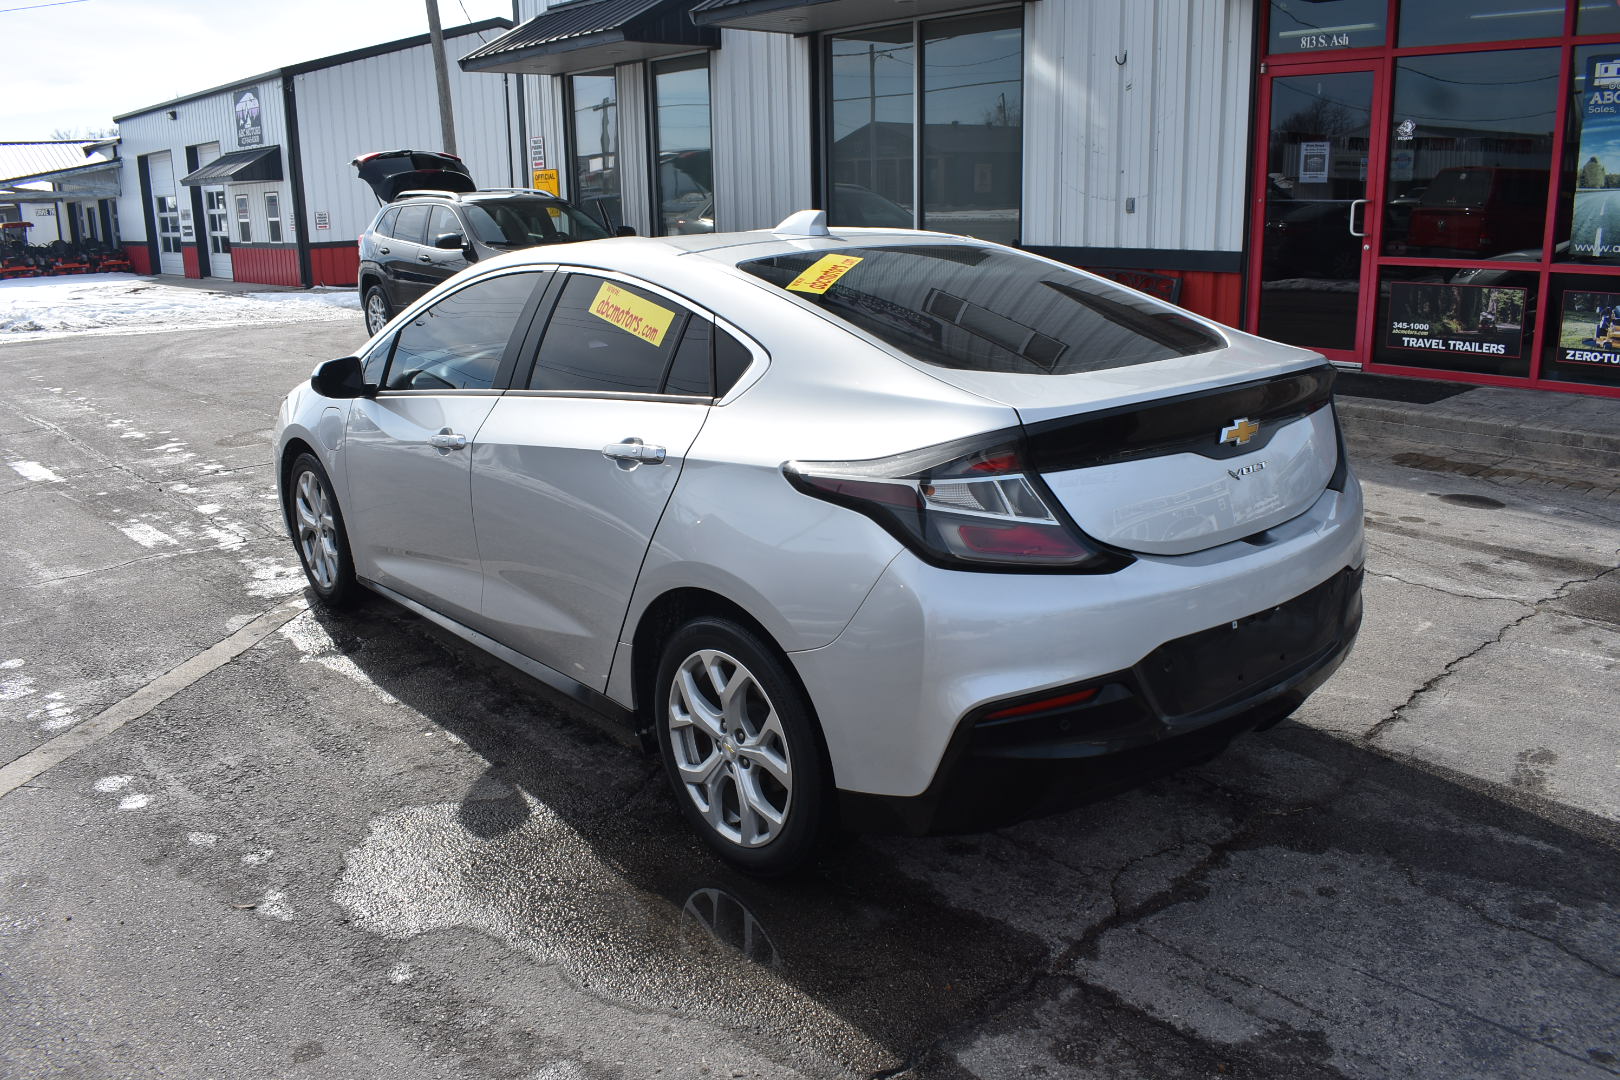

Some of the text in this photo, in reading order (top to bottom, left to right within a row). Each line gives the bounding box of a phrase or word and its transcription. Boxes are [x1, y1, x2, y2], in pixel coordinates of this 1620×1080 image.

[1300, 33, 1350, 49] 813 S. Ash
[1588, 105, 1617, 114] Sales,
[534, 173, 556, 181] OFFICIAL
[595, 294, 659, 341] abcmotors.com
[1392, 321, 1430, 331] 345-1000
[1402, 337, 1506, 355] TRAVEL TRAILERS
[1565, 350, 1620, 364] ZERO-TU
[1227, 460, 1271, 481] VOLT
